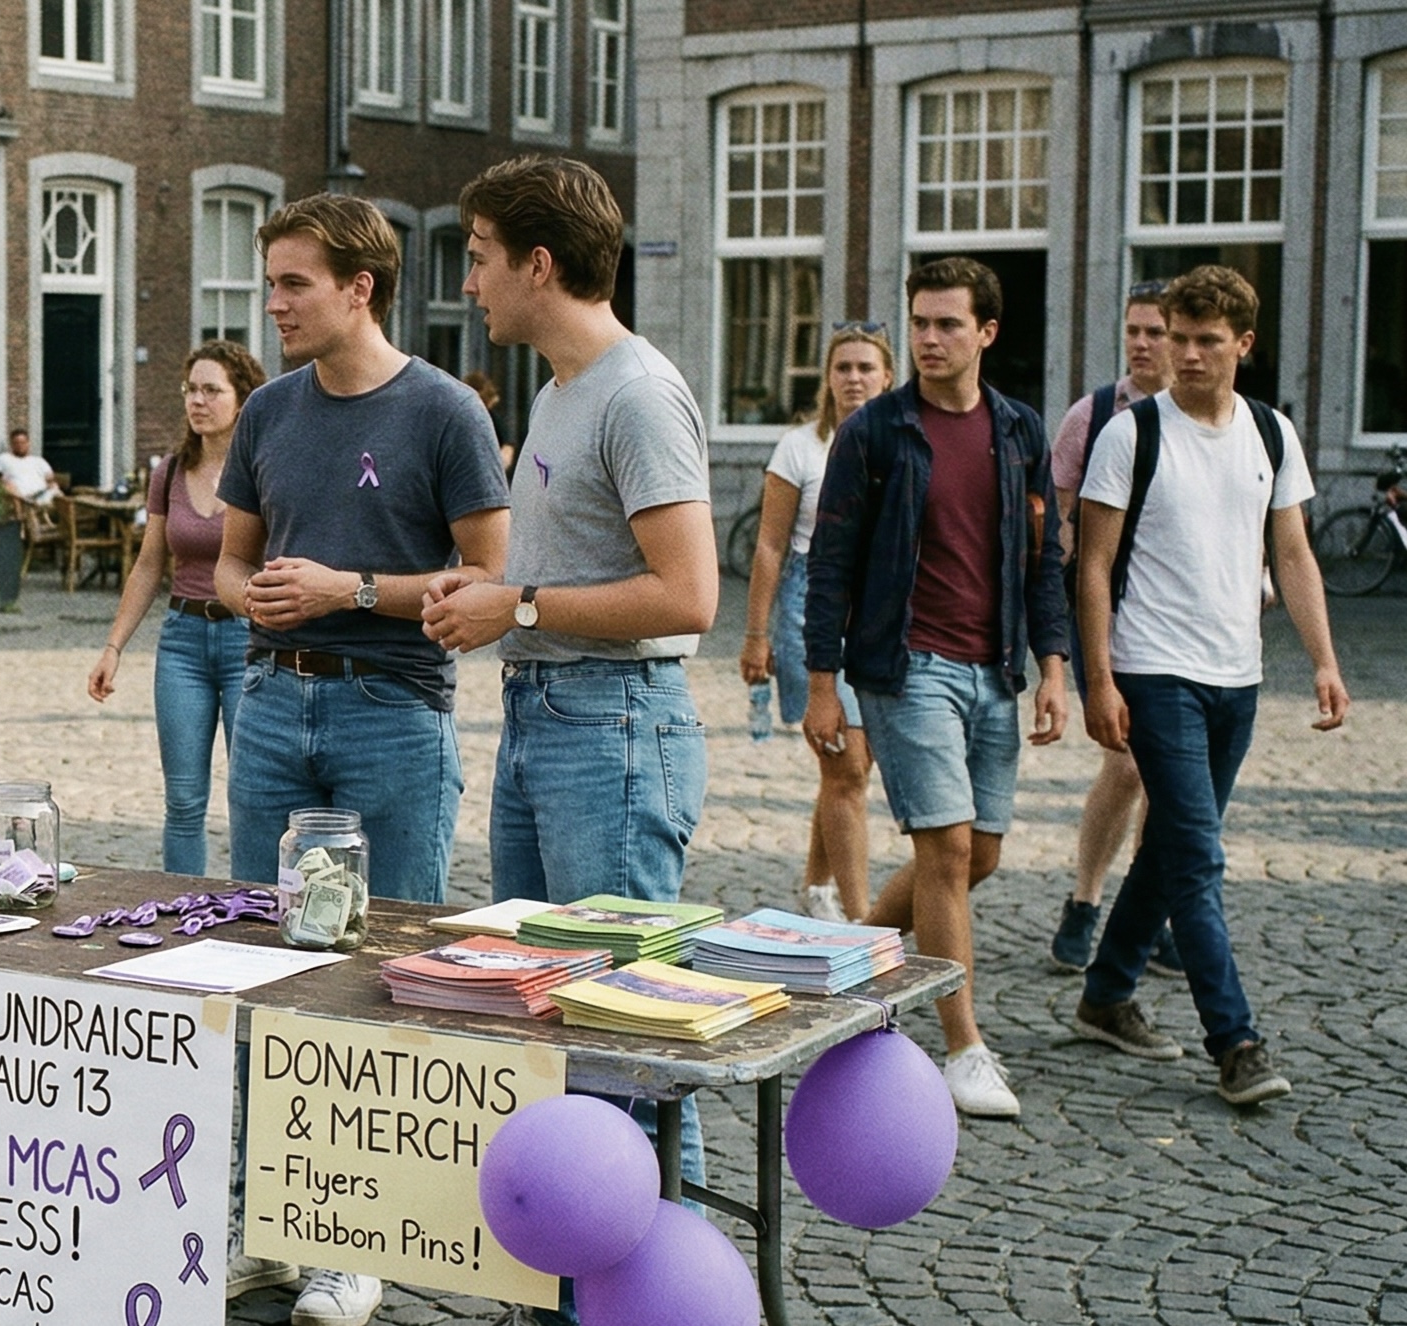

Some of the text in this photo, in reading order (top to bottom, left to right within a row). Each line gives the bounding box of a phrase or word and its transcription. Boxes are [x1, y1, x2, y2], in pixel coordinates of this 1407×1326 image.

[73, 1066, 112, 1117] 13
[264, 1034, 518, 1116] DONATIONS
[285, 1095, 313, 1141] &
[7, 1134, 122, 1204] MCAS
[284, 1154, 380, 1206] Flyers
[283, 1202, 386, 1253] Ribbon
[401, 1219, 481, 1271] Pins!
